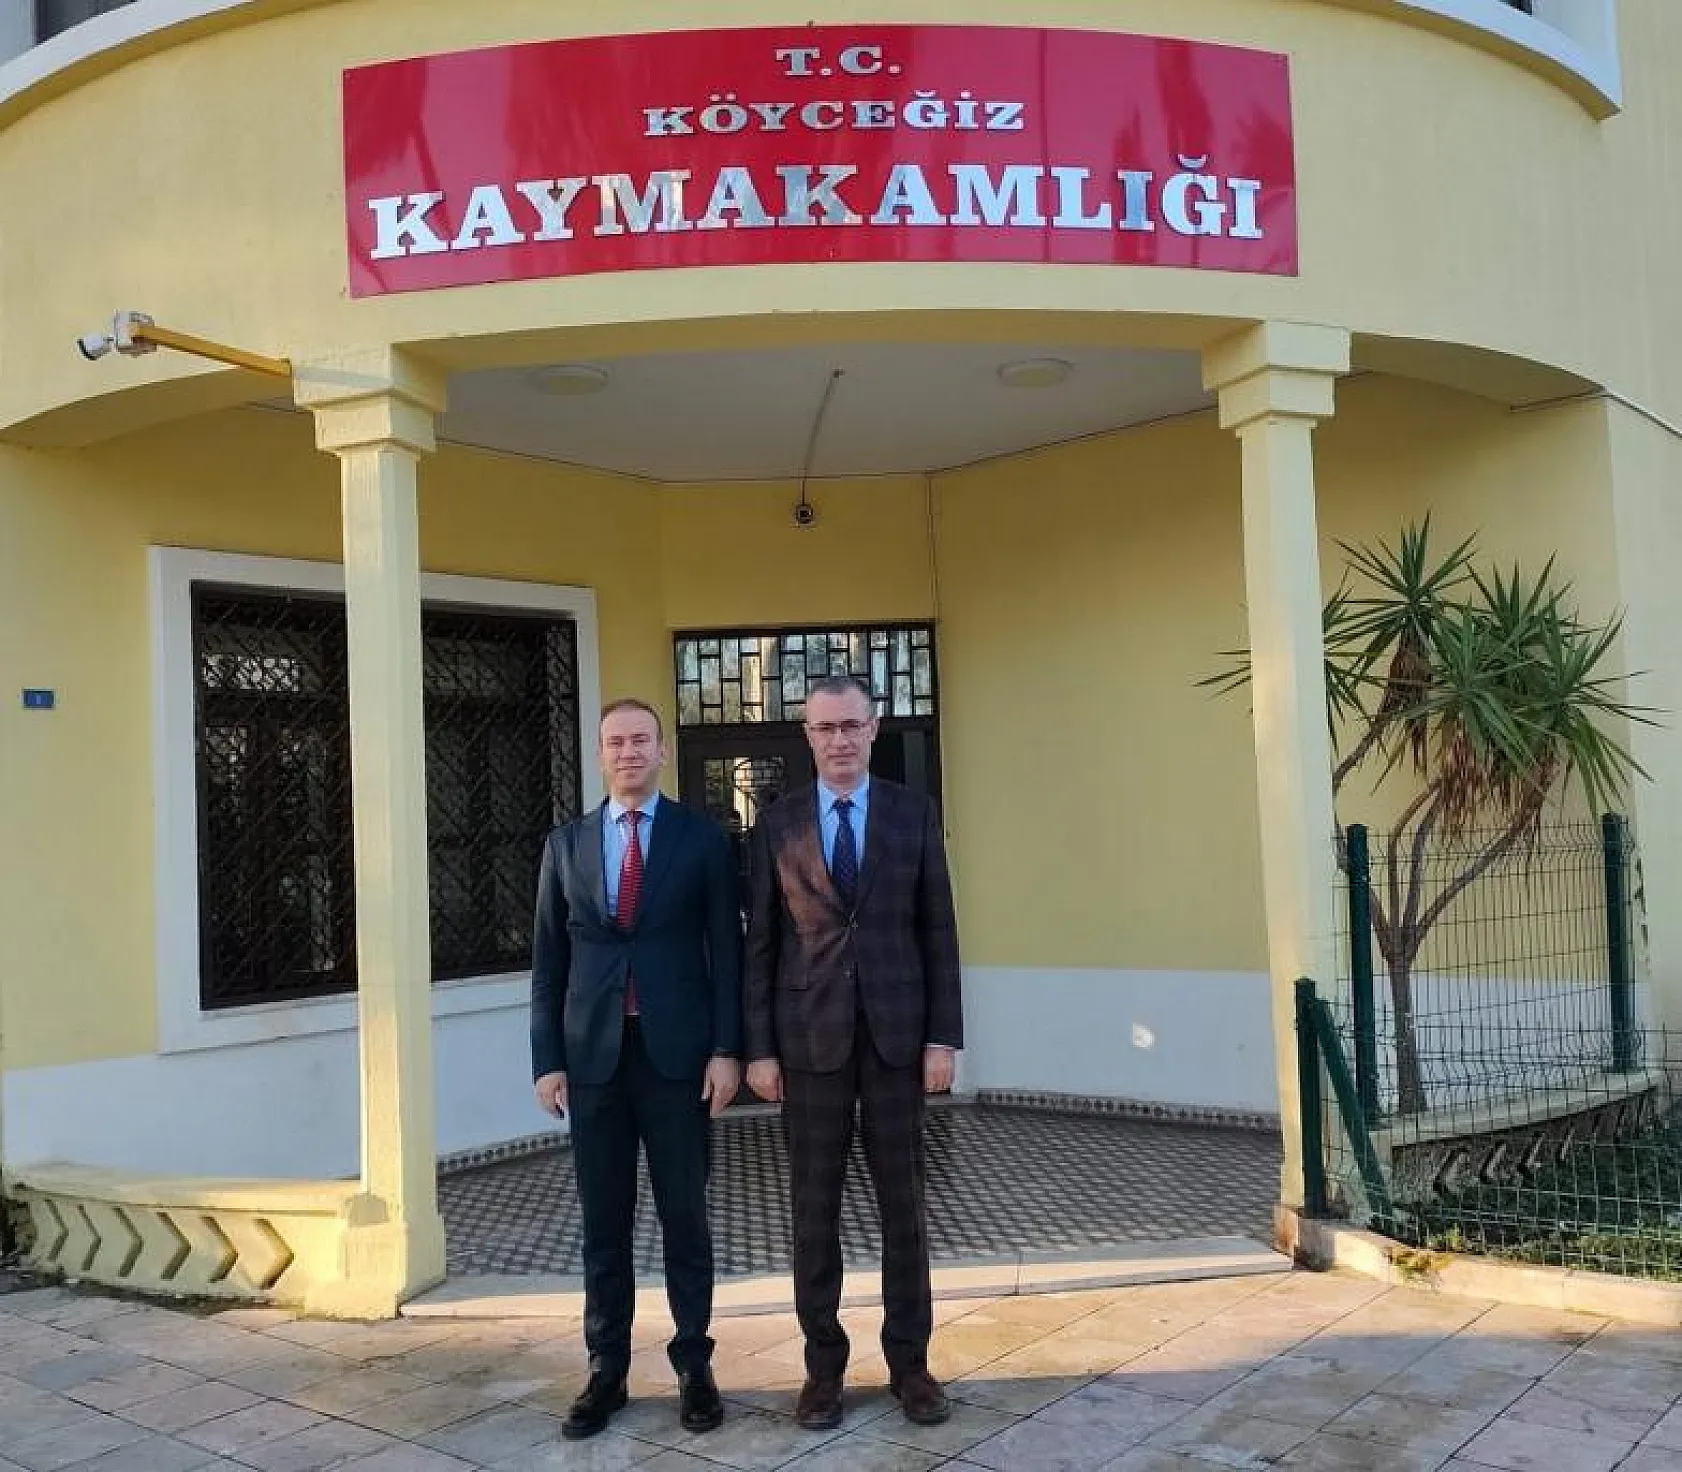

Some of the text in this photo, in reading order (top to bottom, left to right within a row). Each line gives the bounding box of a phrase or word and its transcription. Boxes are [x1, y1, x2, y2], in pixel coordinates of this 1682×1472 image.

[775, 46, 902, 76] T.C.
[643, 91, 1025, 137] KÖYCEĞİZ
[368, 154, 1263, 260] KAYMAKAMLIĞI
